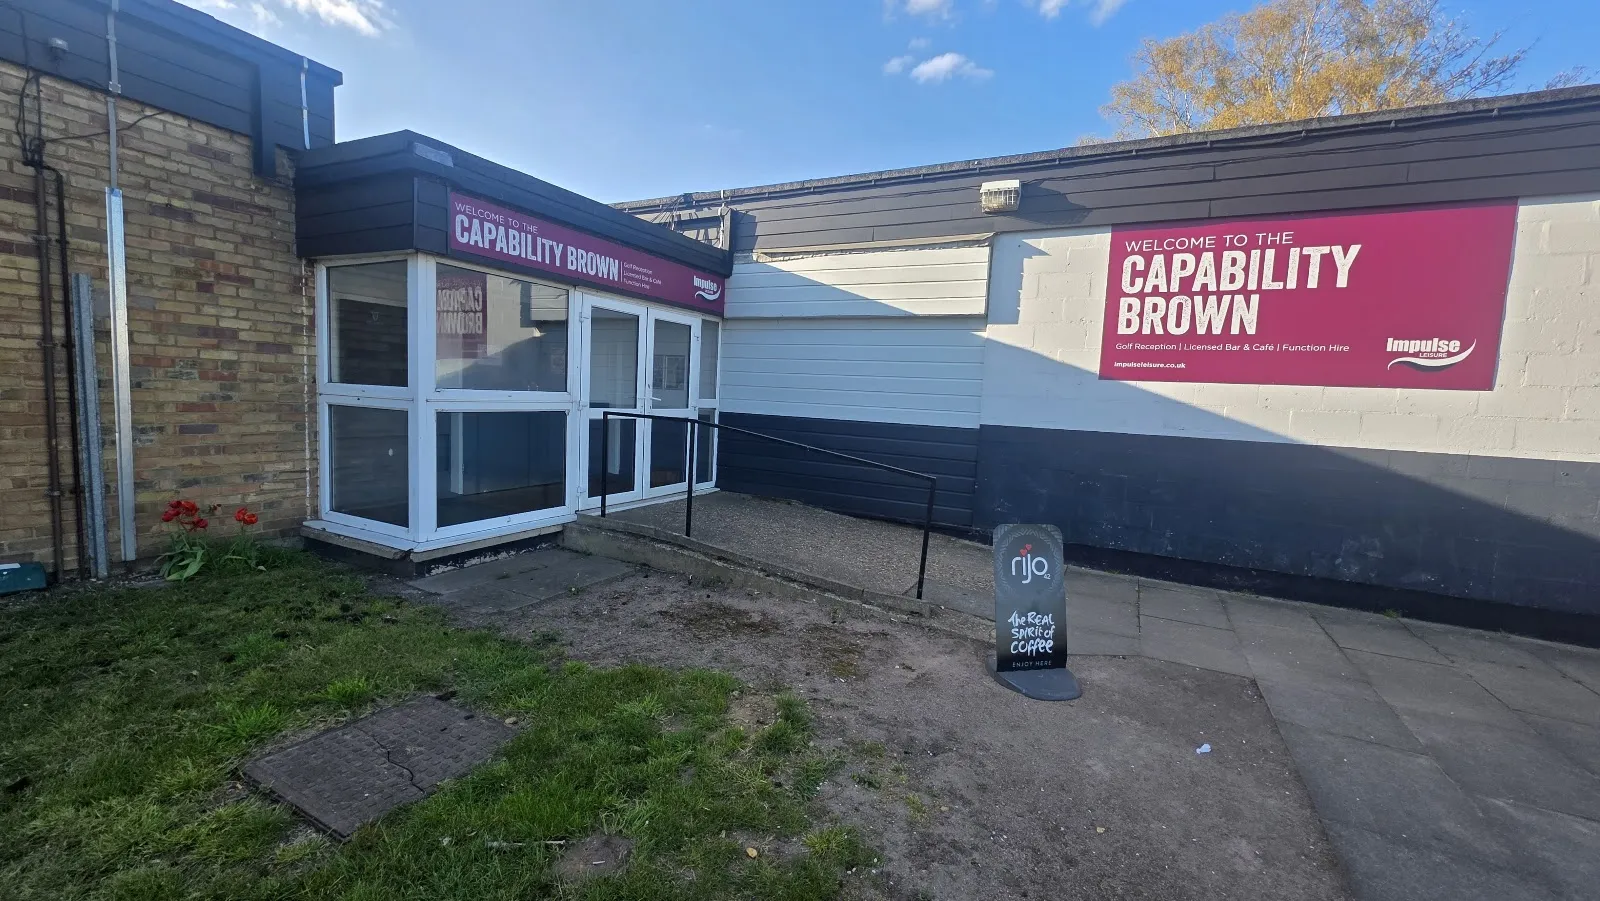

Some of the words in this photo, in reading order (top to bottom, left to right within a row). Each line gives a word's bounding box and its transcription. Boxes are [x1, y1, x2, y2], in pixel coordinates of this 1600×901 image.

[455, 202, 505, 225] WELCOME
[508, 217, 520, 228] TO
[522, 222, 539, 234] THE
[455, 214, 564, 267] CAPABILITY
[567, 246, 619, 281] BROWN
[1125, 235, 1217, 252] WELCOME
[1223, 234, 1248, 247] TO
[1256, 231, 1294, 245] THE
[1121, 244, 1362, 294] CAPABILITY
[693, 275, 718, 292] Impulse
[1117, 293, 1260, 335] BROWN
[1115, 342, 1134, 350] Golf
[1134, 342, 1177, 352] Reception
[1184, 342, 1223, 351] Licensed
[1225, 343, 1241, 351] Bar
[1243, 343, 1251, 351] &
[1252, 342, 1275, 351] Café
[1282, 343, 1326, 352] Function
[1329, 344, 1350, 352] Hire
[1386, 337, 1461, 354] Impulse
[1114, 361, 1186, 369] impulseleisure.co.uk
[1011, 551, 1048, 584] rijo
[1007, 610, 1026, 627] The
[1027, 611, 1055, 626] REAL
[1043, 625, 1056, 640] of
